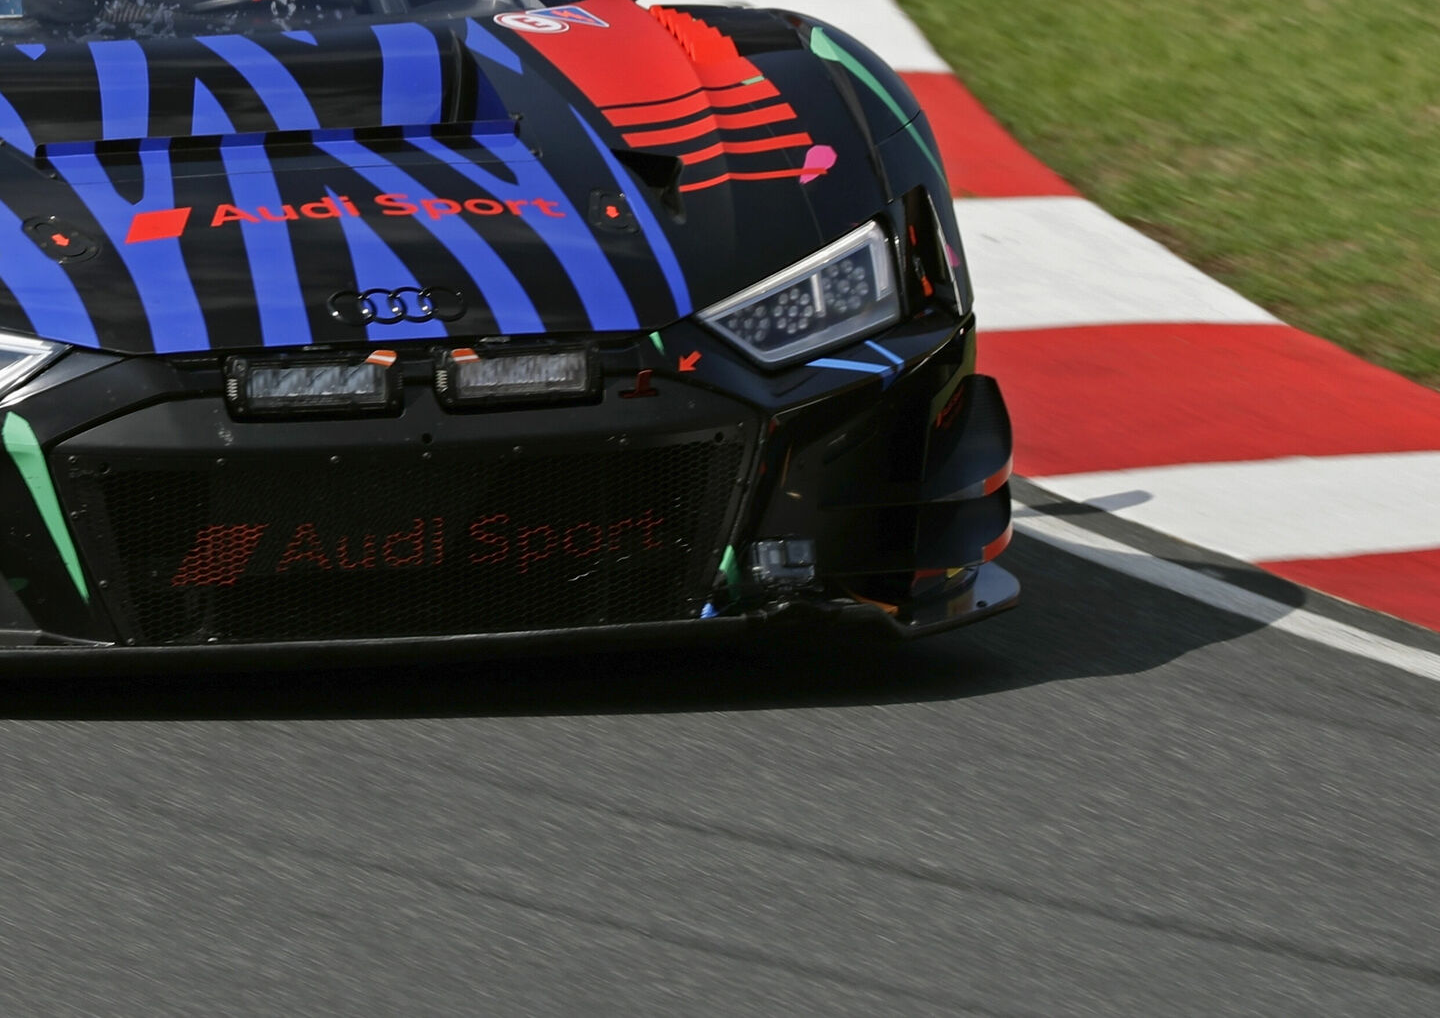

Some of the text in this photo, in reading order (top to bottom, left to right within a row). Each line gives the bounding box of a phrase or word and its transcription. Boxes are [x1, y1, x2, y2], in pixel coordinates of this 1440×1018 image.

[210, 192, 566, 228] Audi Sport
[275, 509, 664, 574] Audi Sport
